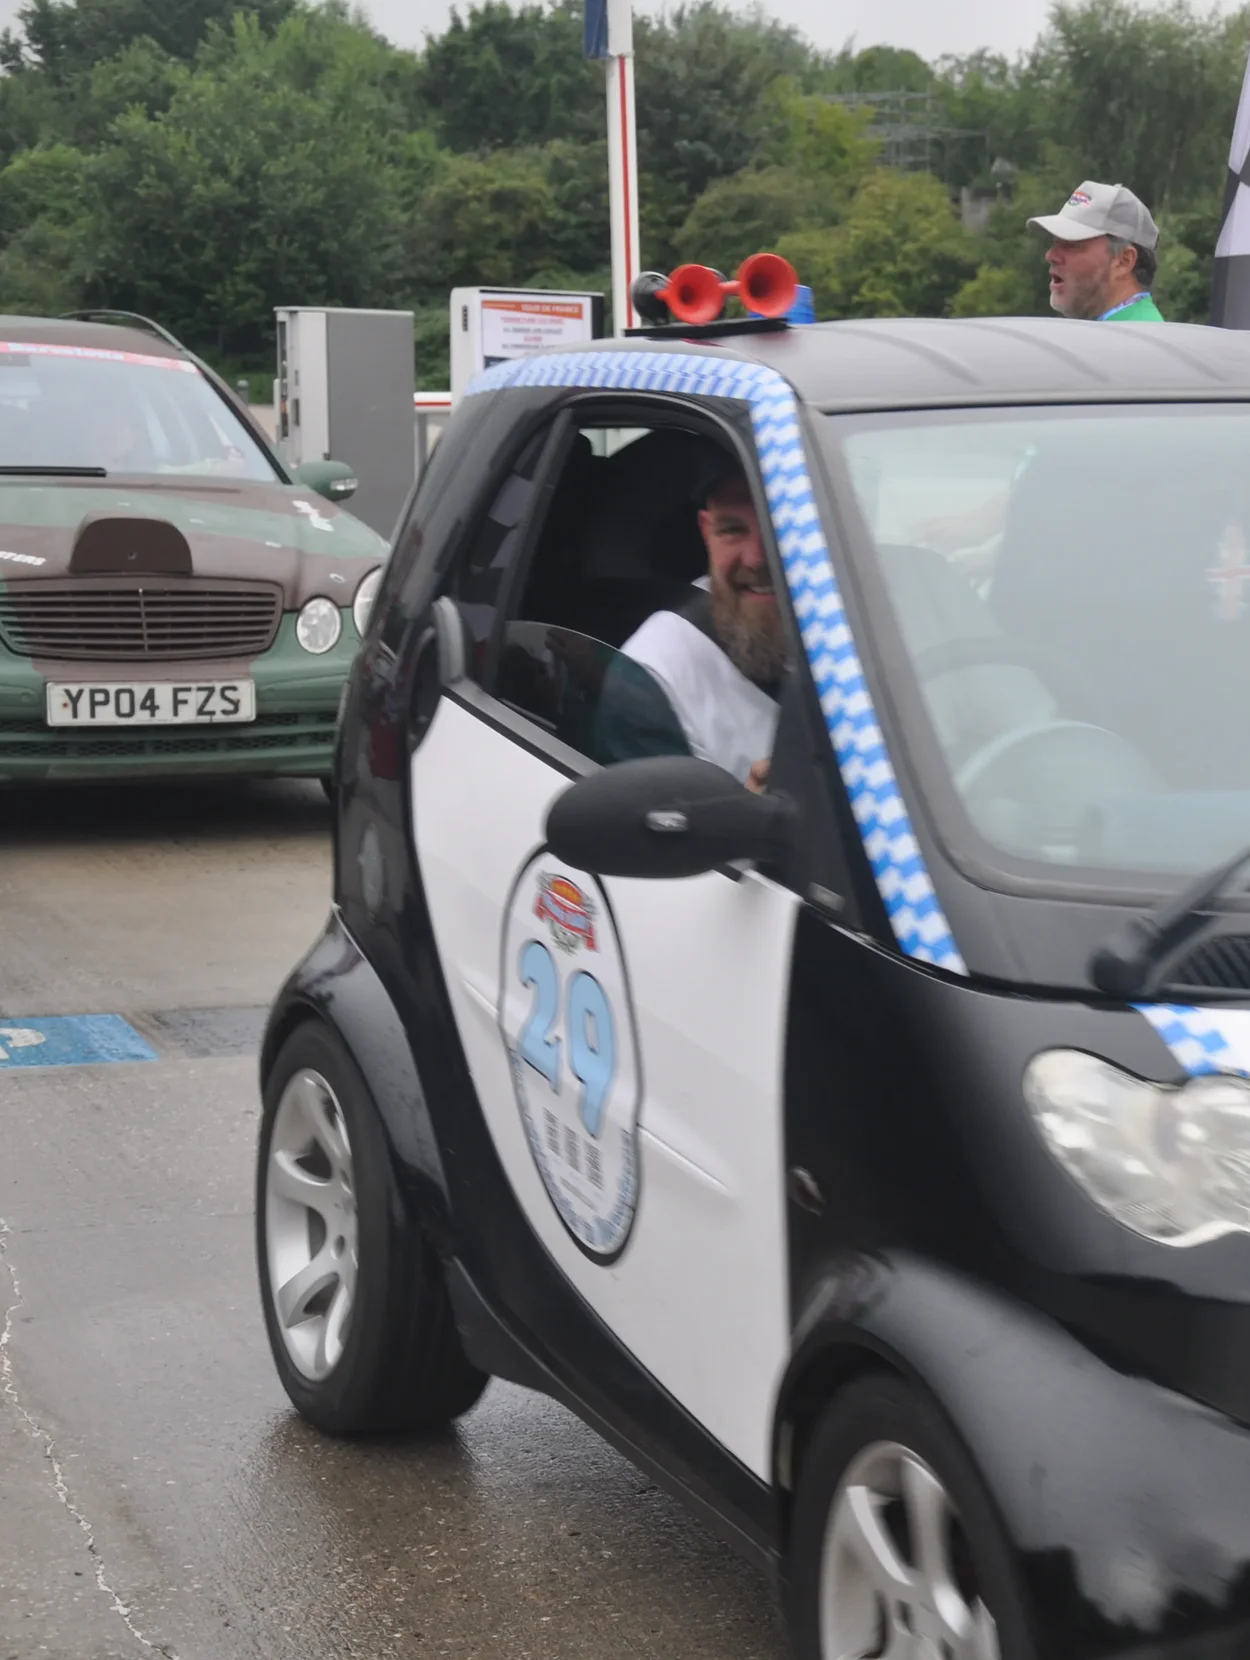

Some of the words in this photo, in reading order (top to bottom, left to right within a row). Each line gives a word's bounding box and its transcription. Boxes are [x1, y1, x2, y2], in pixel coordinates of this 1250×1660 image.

[63, 687, 160, 719] YP04
[171, 685, 241, 717] FZS
[519, 938, 616, 1140] 29
